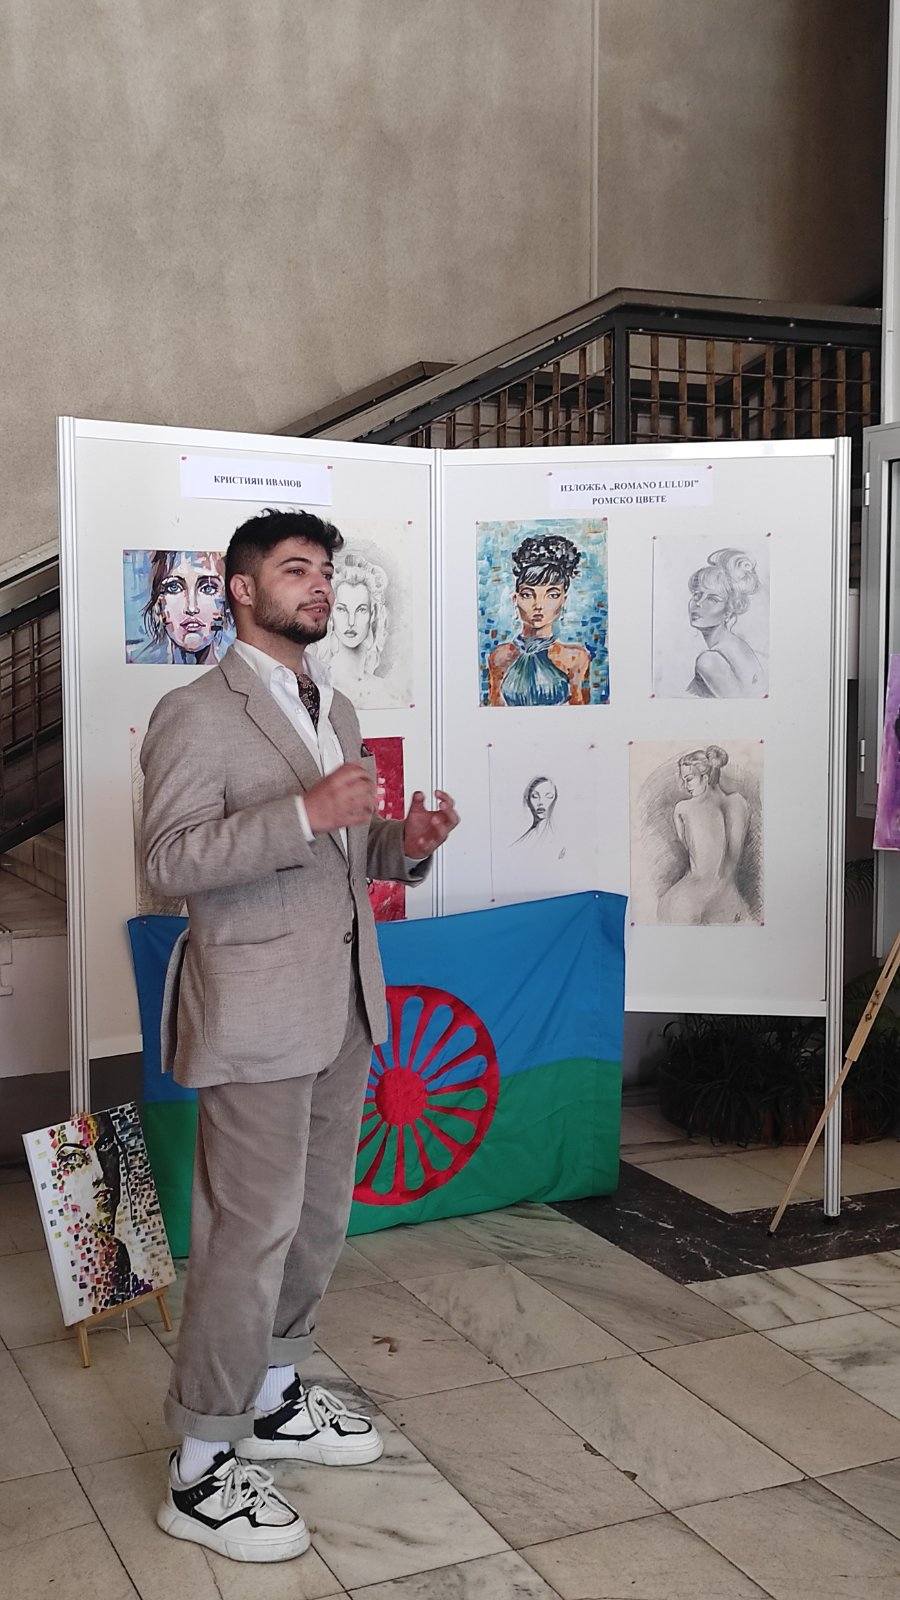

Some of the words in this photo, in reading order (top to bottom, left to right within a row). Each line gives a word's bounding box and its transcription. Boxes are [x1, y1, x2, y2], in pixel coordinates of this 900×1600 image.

[214, 475, 263, 485] КРИСТИЯН
[265, 478, 302, 488] ИВАНОВ
[560, 483, 607, 492] ИЗЛОЖБА
[592, 496, 633, 505] РОМСКО
[635, 495, 667, 505] ЦВЕТЕ
